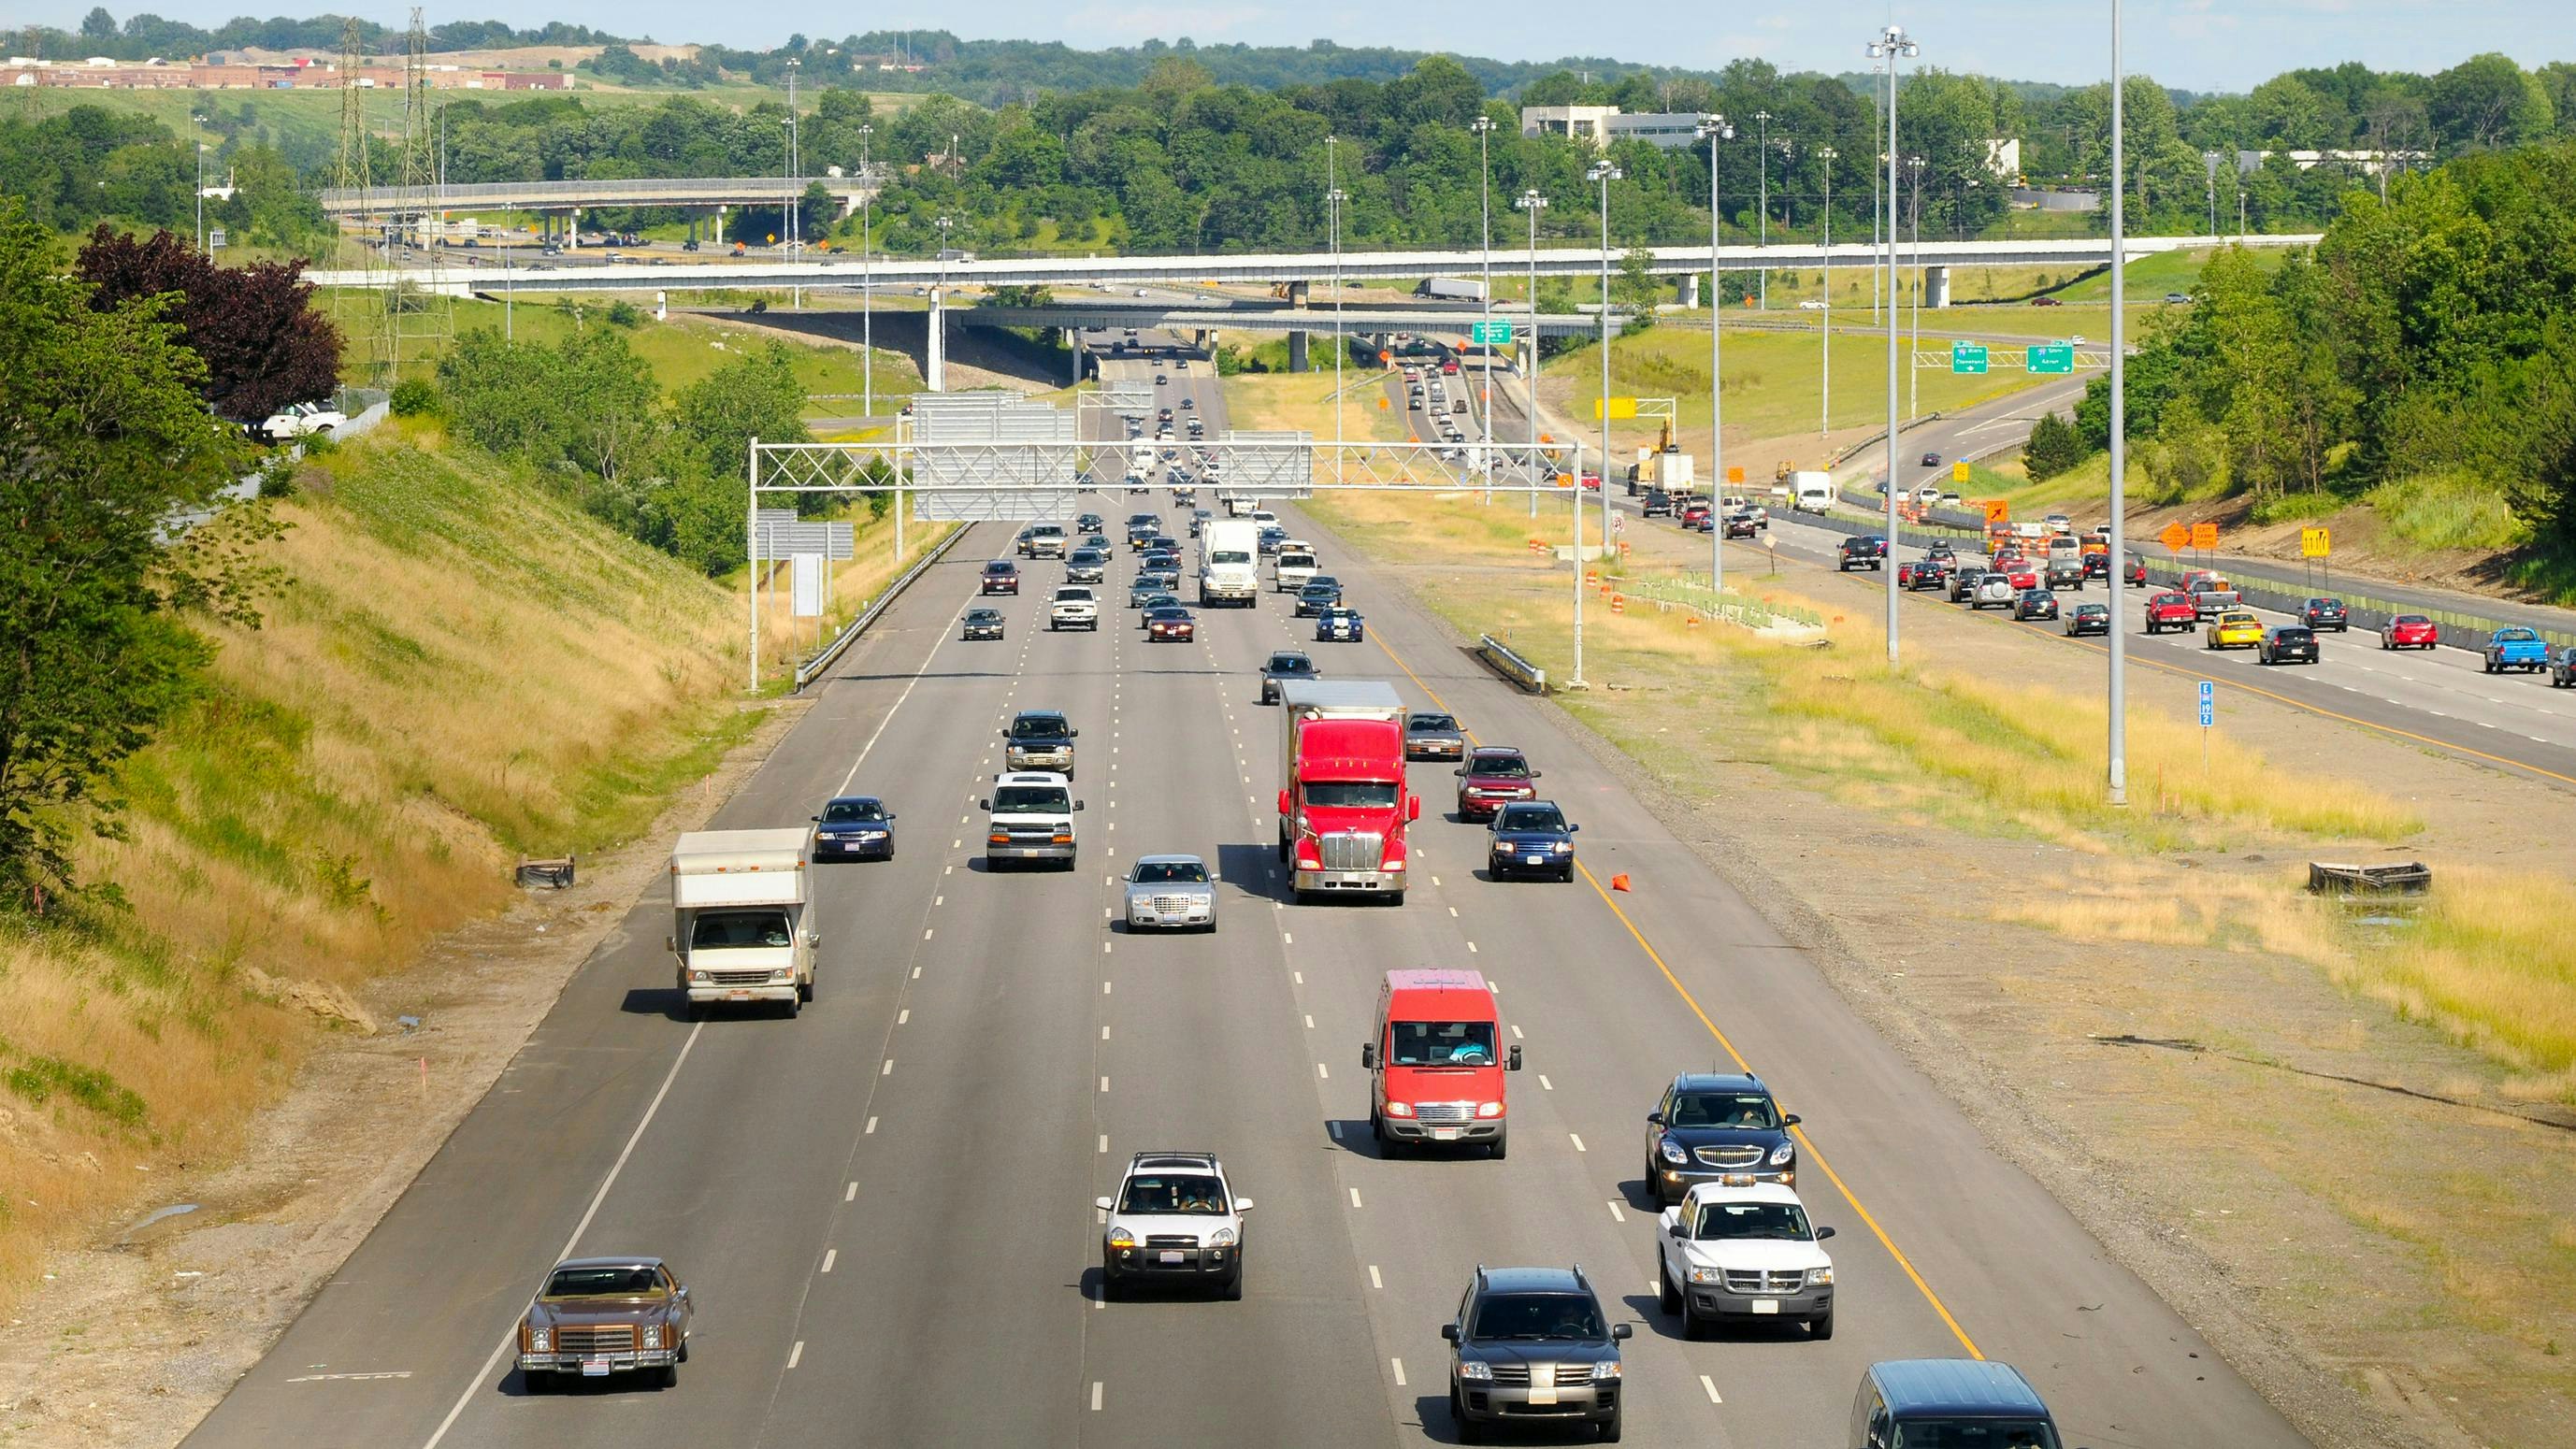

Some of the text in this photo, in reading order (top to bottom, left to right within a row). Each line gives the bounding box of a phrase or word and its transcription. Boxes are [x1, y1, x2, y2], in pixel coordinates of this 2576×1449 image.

[2203, 684, 2209, 694] E
[2202, 703, 2211, 712] 19
[2203, 714, 2209, 724] 2
